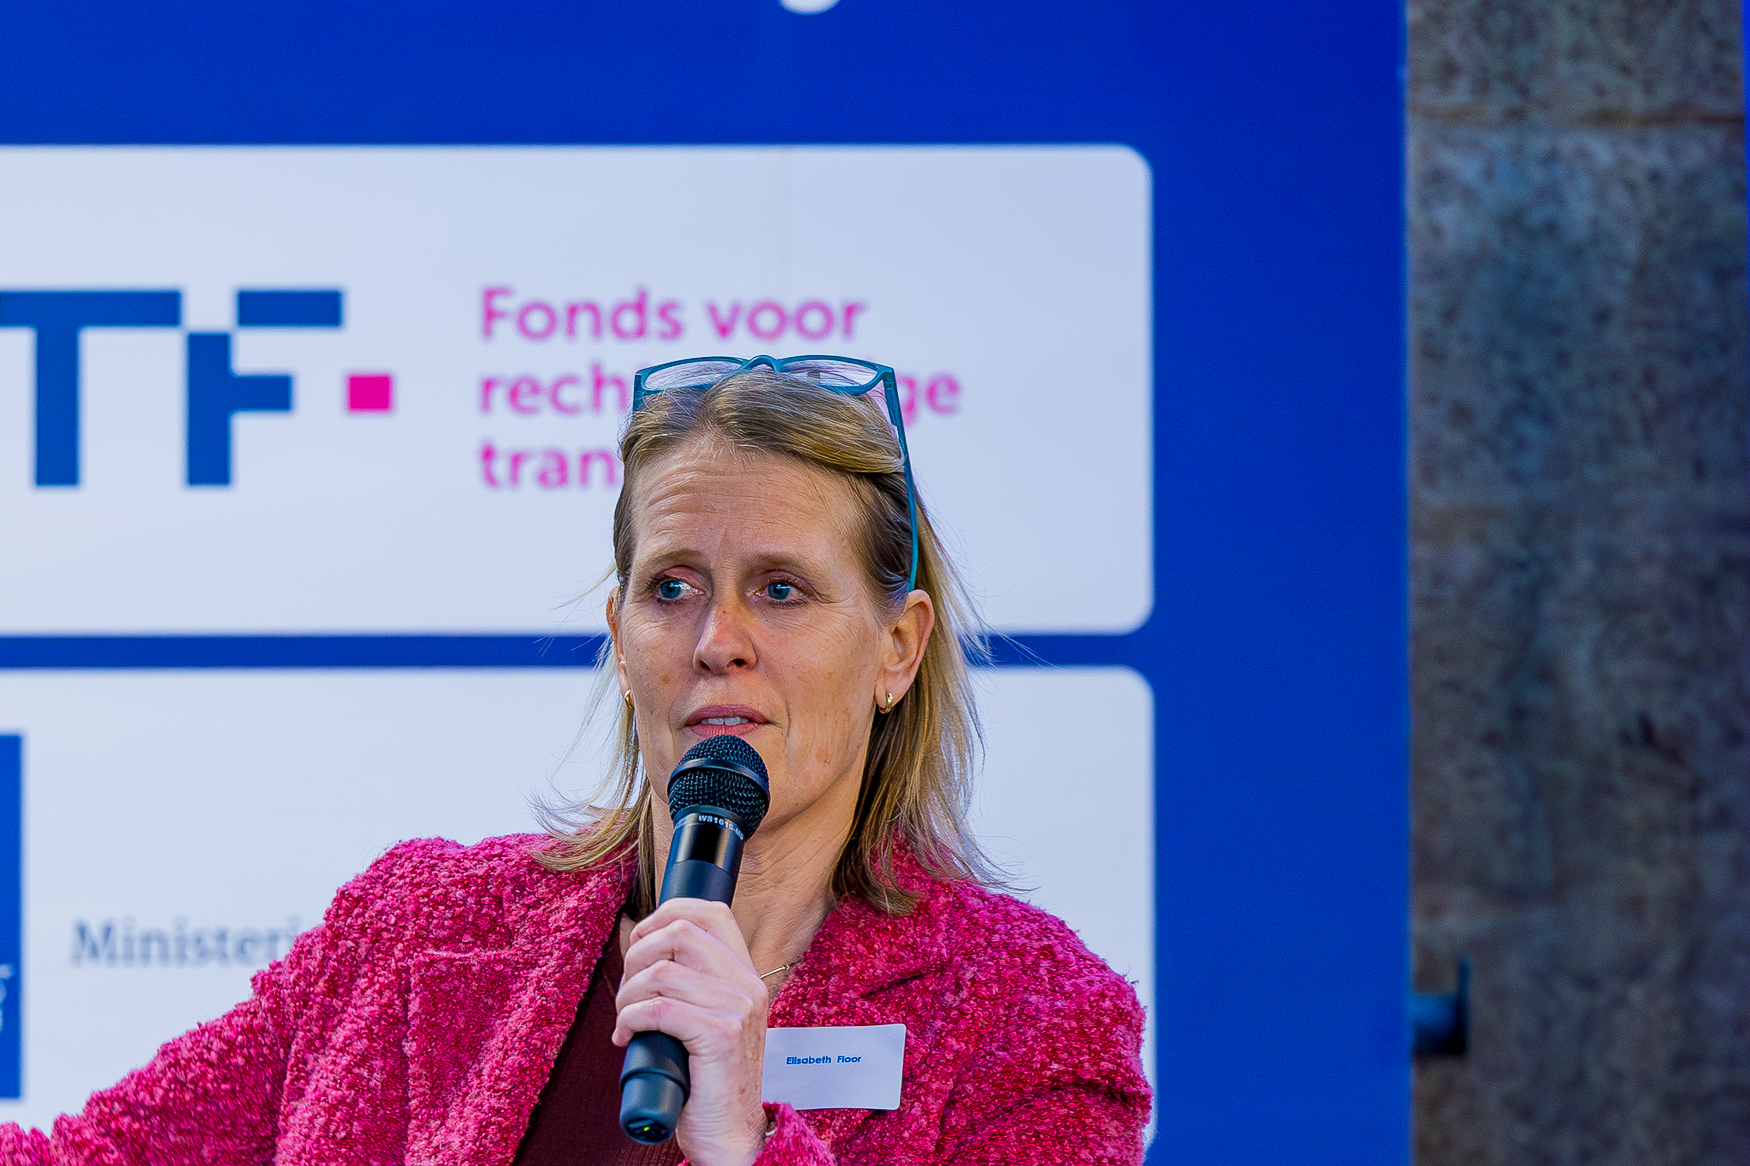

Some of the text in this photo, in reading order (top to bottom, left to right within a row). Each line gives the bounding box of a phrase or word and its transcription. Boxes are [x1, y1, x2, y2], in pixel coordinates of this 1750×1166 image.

[481, 286, 869, 342] Fonds voor
[481, 444, 620, 488] tran
[69, 914, 301, 967] Ministeri
[785, 1055, 862, 1065] Elisabeth Floor
